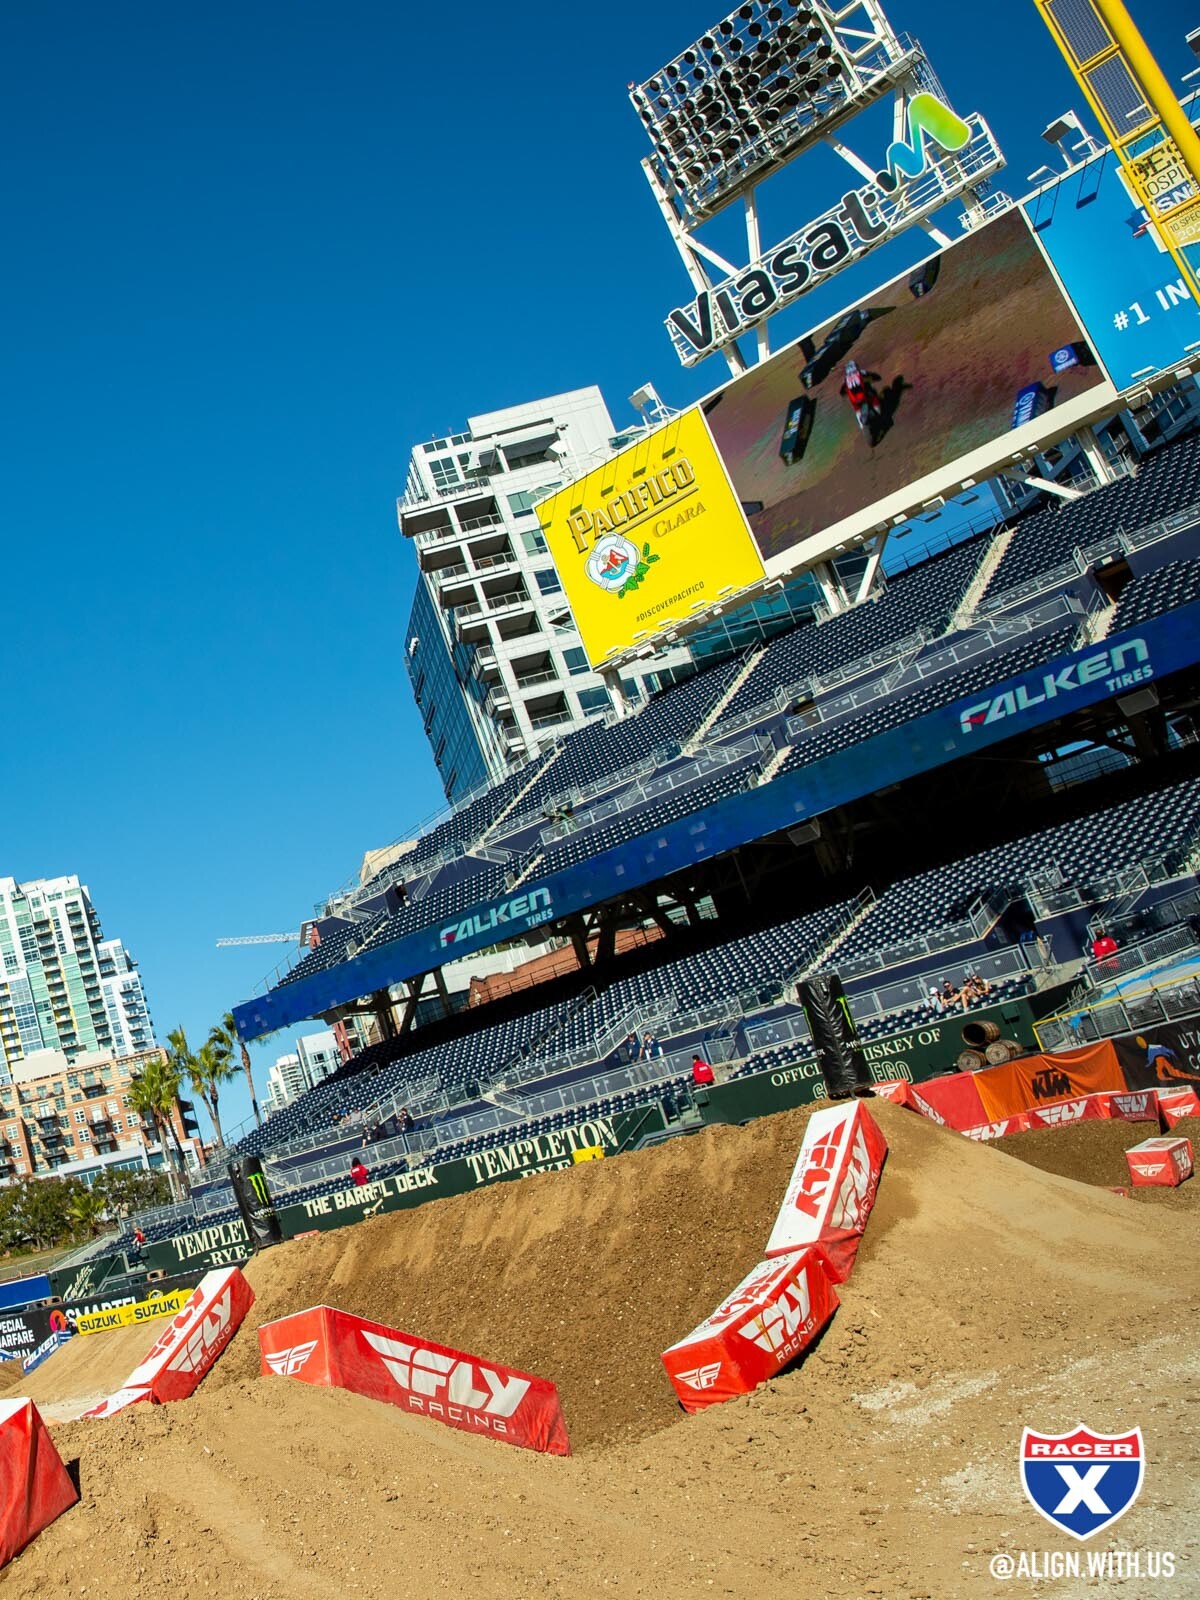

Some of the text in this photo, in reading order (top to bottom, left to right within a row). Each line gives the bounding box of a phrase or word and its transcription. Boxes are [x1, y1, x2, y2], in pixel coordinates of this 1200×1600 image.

[1113, 278, 1191, 331] #1 IN
[566, 456, 696, 554] PACIFICO
[636, 581, 705, 623] #DISCOVERPACIFICO
[960, 637, 1149, 734] FALKEN
[1105, 664, 1154, 692] TIRES
[440, 887, 553, 948] FALKEN
[525, 907, 554, 928] TIRES
[771, 1027, 942, 1087] OFFICI ISKEY OF
[1031, 1067, 1072, 1100] KTM
[1035, 1099, 1088, 1125] FLY
[466, 1116, 619, 1184] TEMPLETON
[303, 1195, 333, 1218] THE
[395, 1166, 439, 1194] DECK
[172, 1220, 249, 1261] TEMPLET
[80, 1298, 180, 1332] SUZUKI SUZUKI
[360, 1329, 532, 1418] FLY
[409, 1396, 508, 1434] RACING
